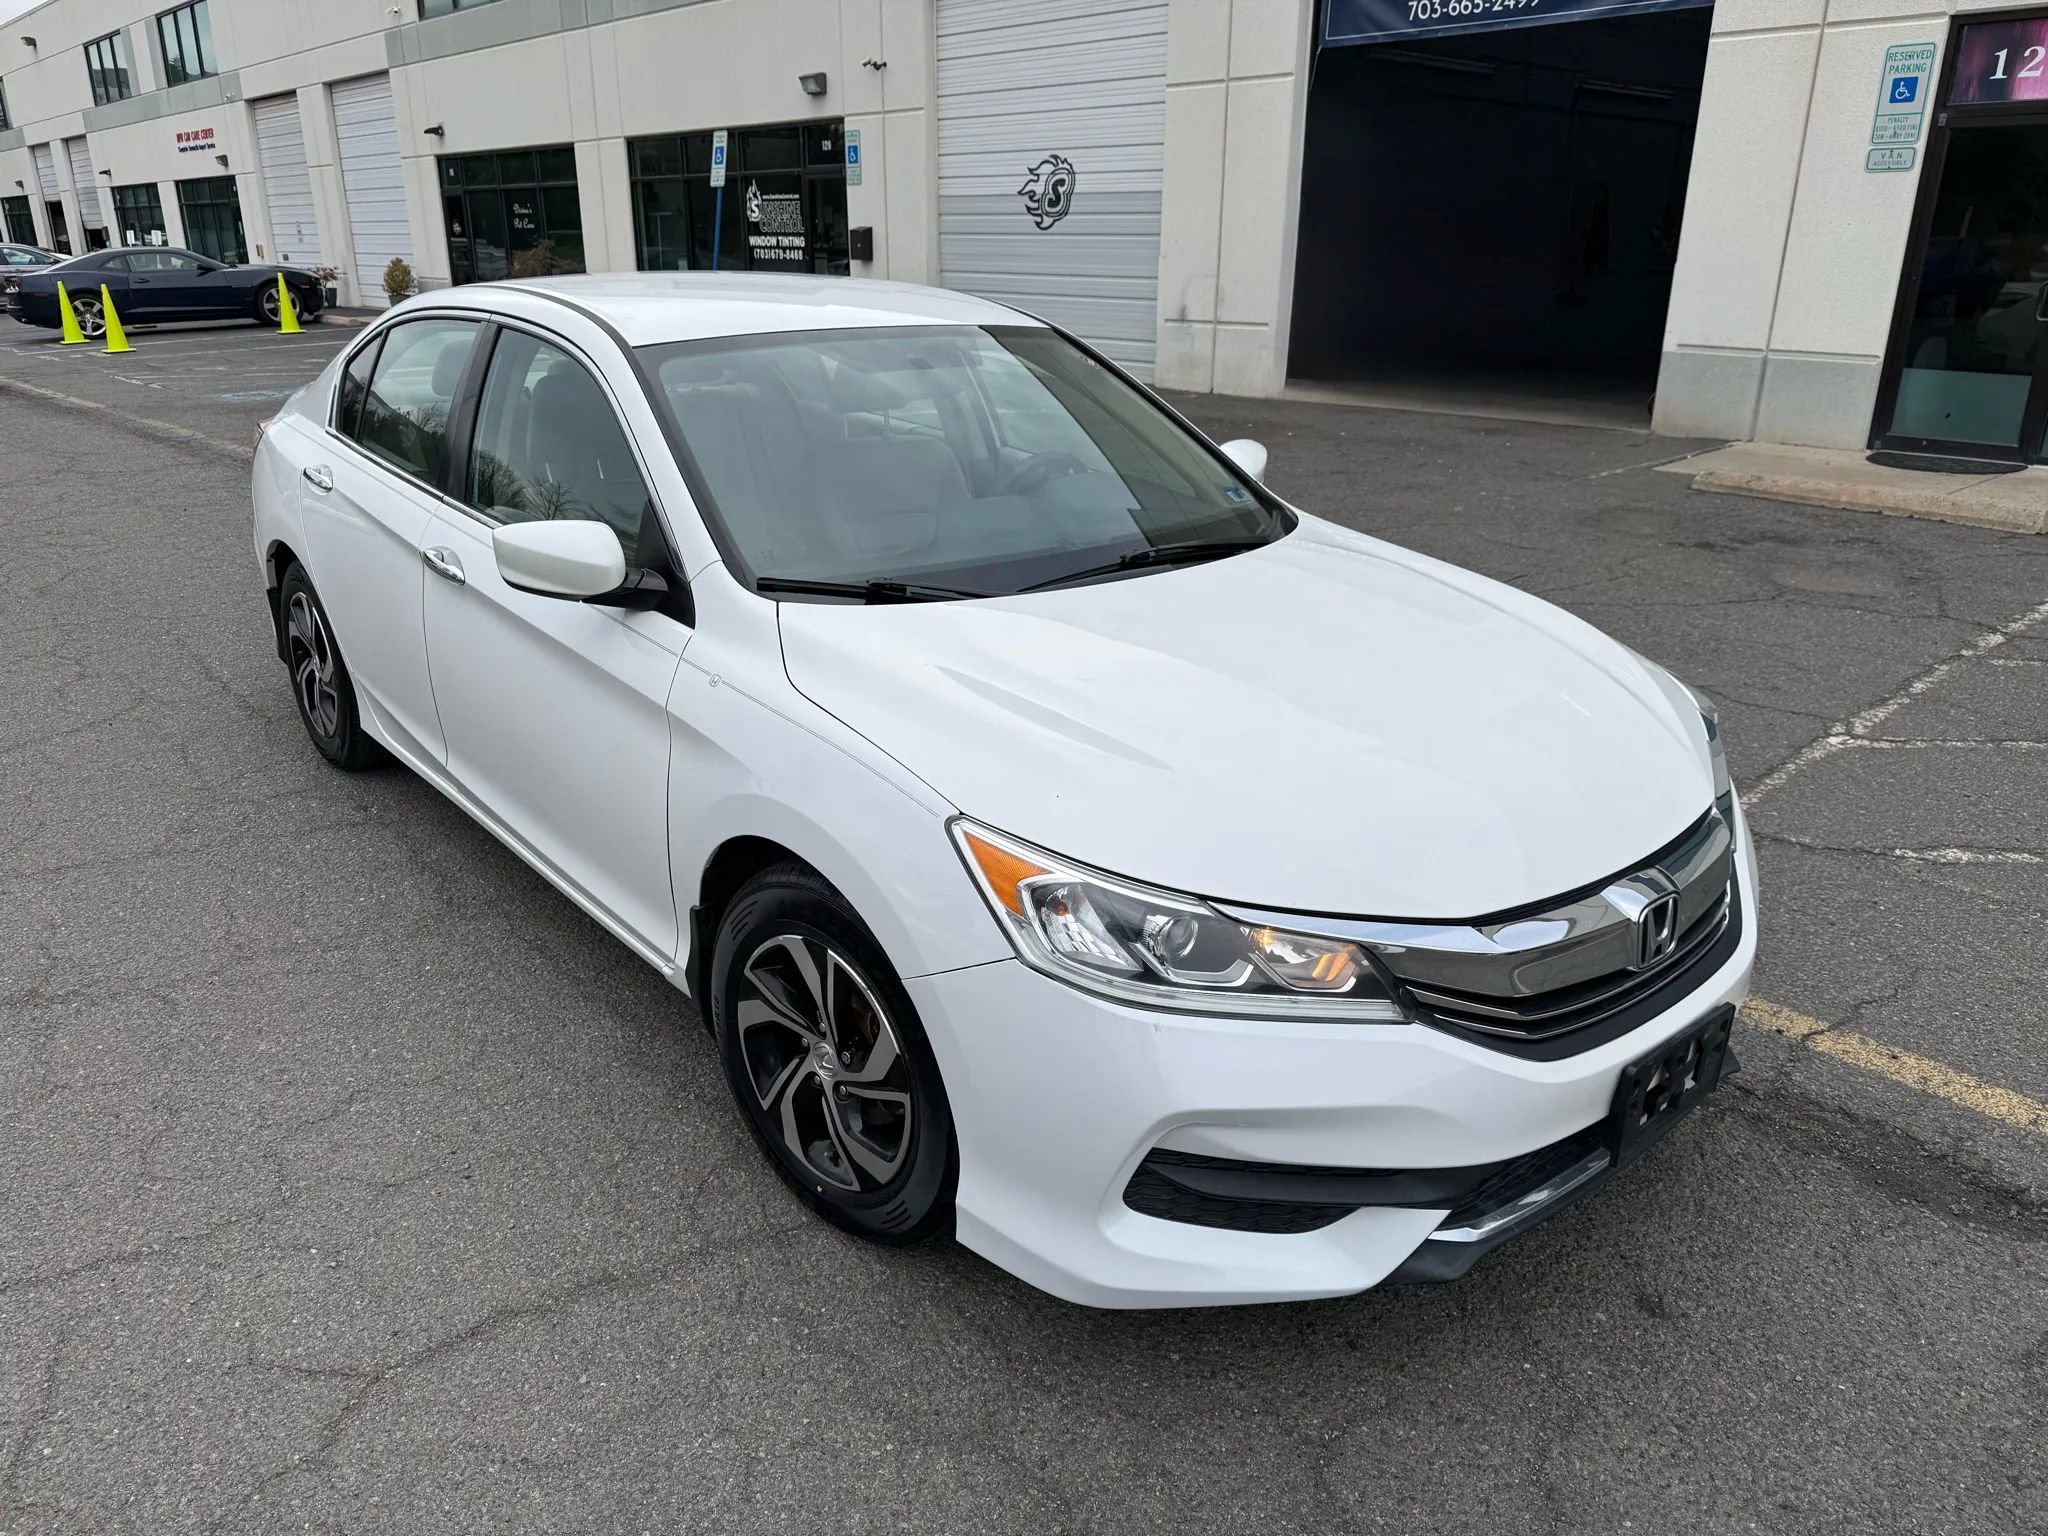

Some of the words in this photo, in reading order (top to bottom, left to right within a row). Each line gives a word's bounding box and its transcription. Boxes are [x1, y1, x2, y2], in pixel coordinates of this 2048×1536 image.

[1888, 49, 1933, 62] RESERVED
[1888, 63, 1927, 74] PARKING
[1880, 152, 1903, 160] VAN
[759, 217, 805, 233] CONTROL
[748, 235, 777, 247] WINDOW
[778, 235, 806, 248] TINTING
